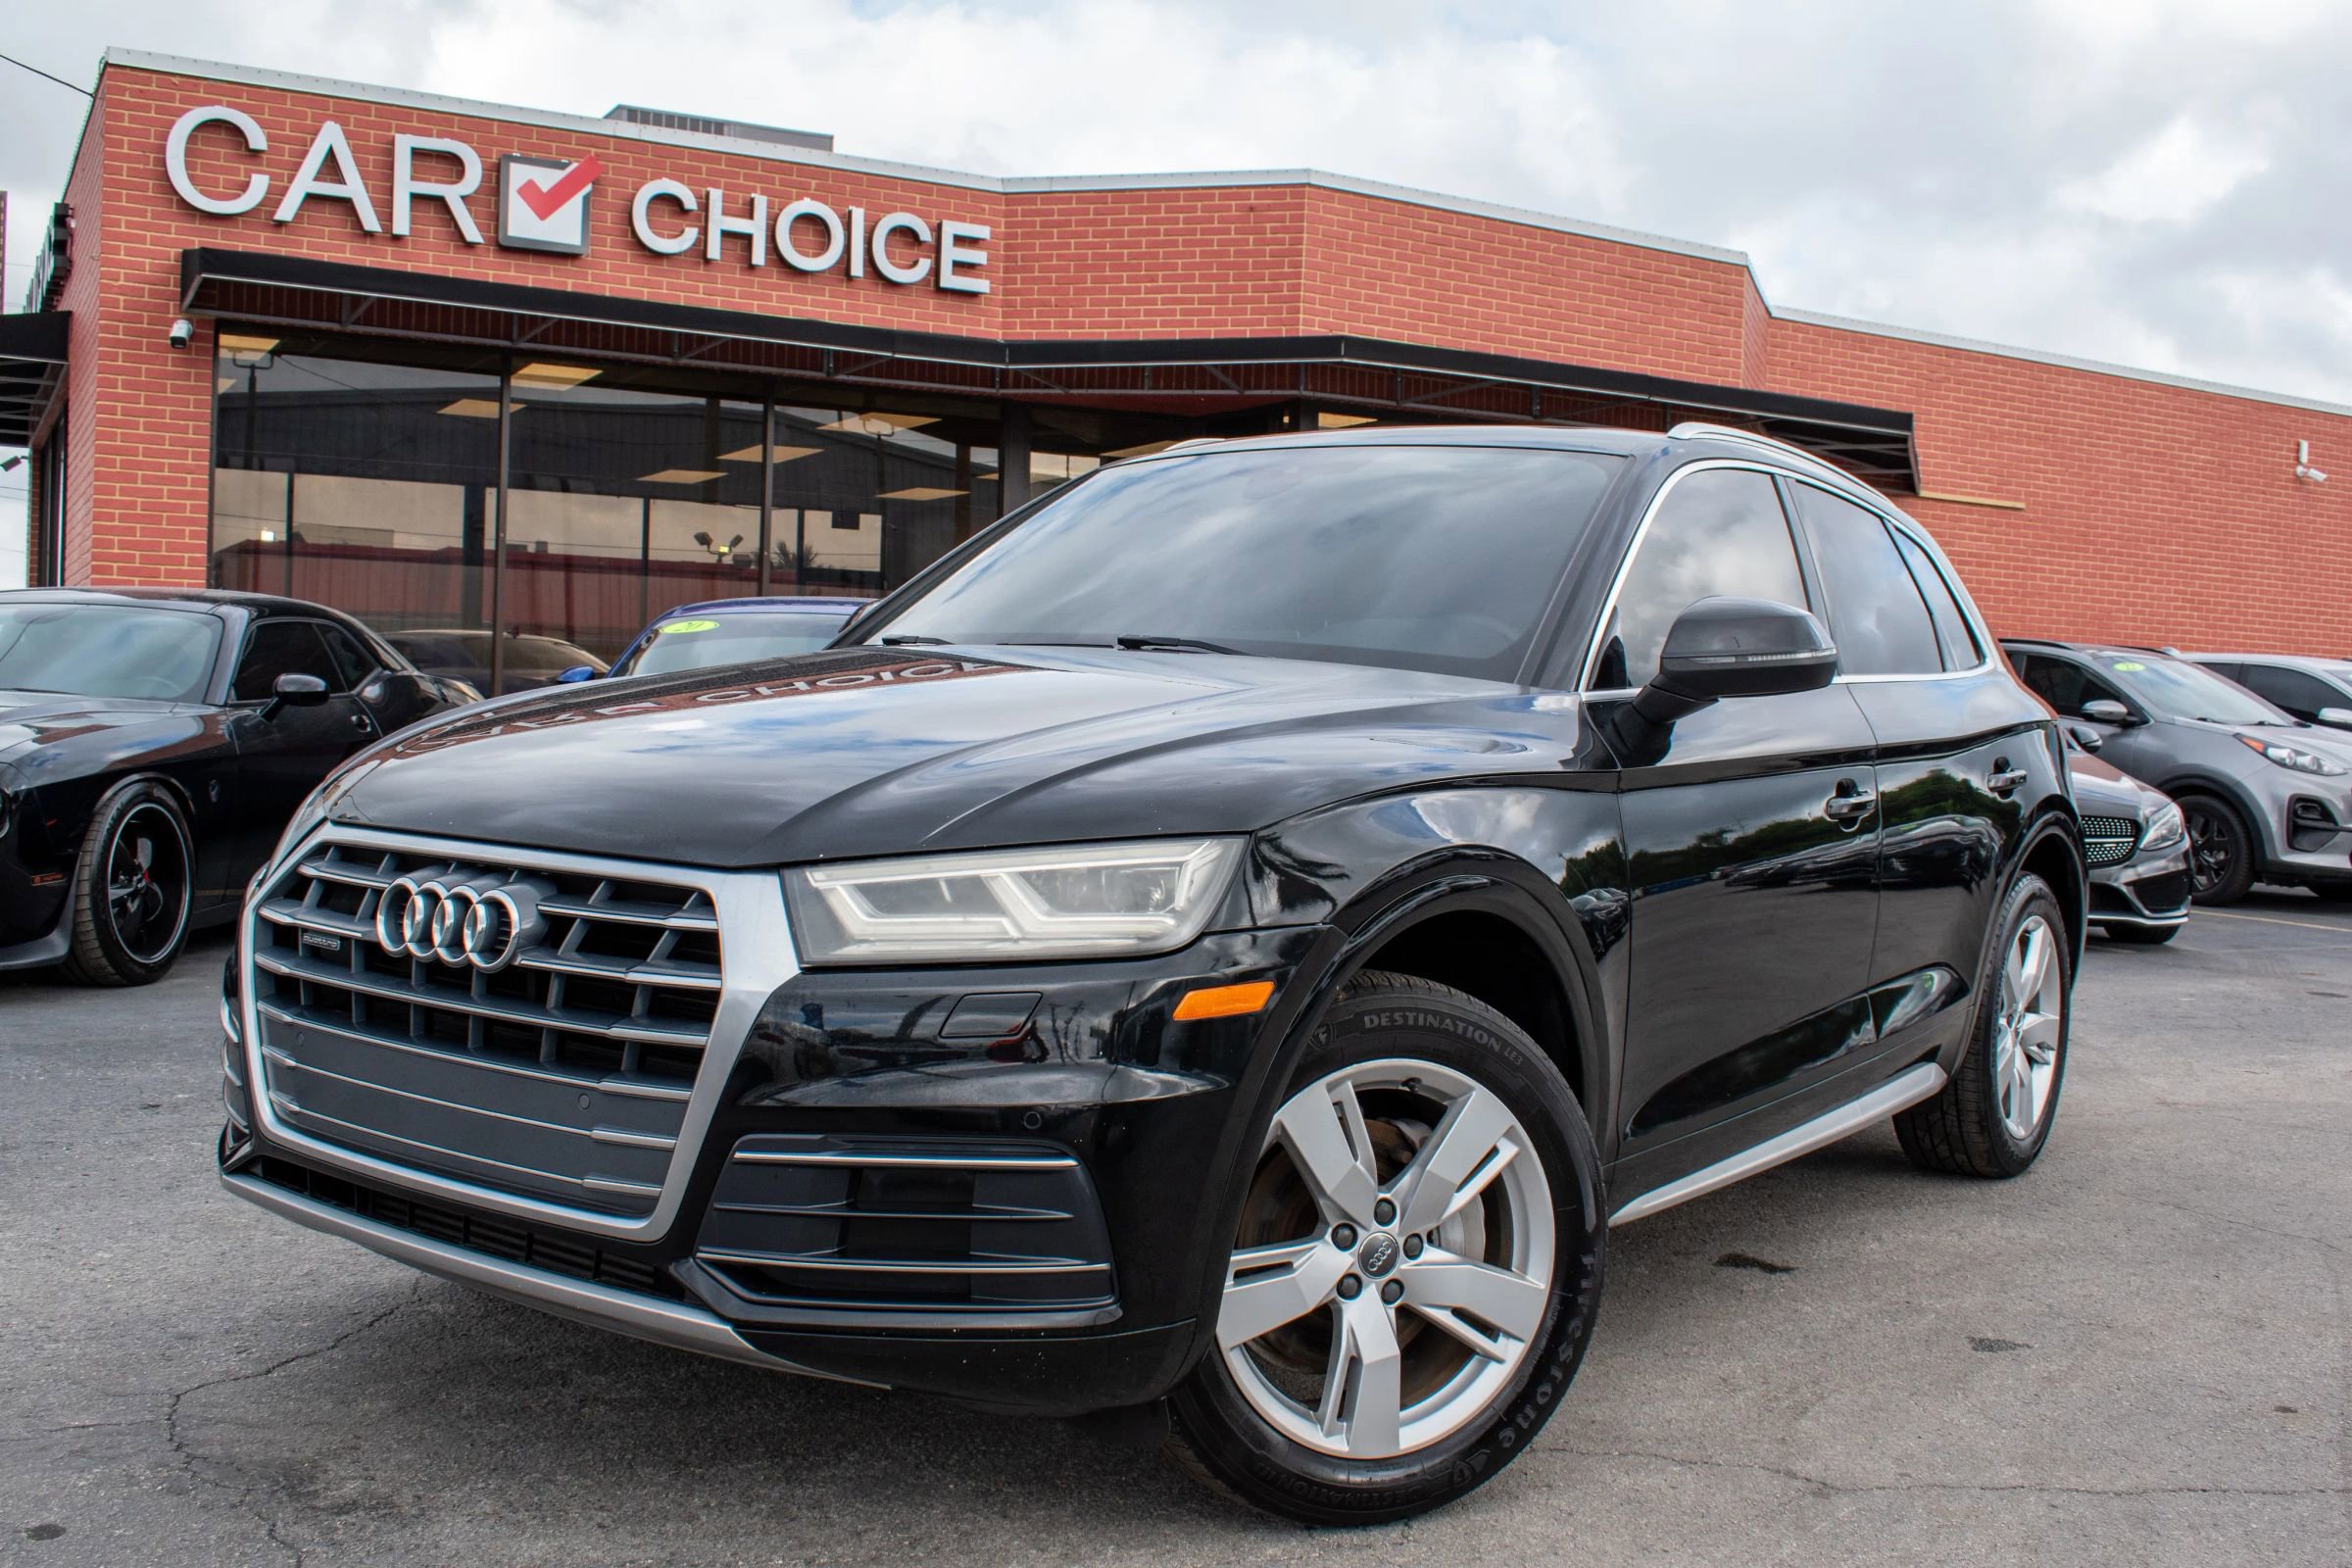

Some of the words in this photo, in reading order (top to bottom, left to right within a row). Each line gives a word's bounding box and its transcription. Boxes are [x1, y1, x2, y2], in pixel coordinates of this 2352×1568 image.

[166, 105, 484, 245] CAR
[632, 177, 991, 294] CHOICE
[303, 934, 338, 949] quattro
[1363, 1011, 1501, 1053] DESTINATION
[1503, 1046, 1524, 1067] LE3
